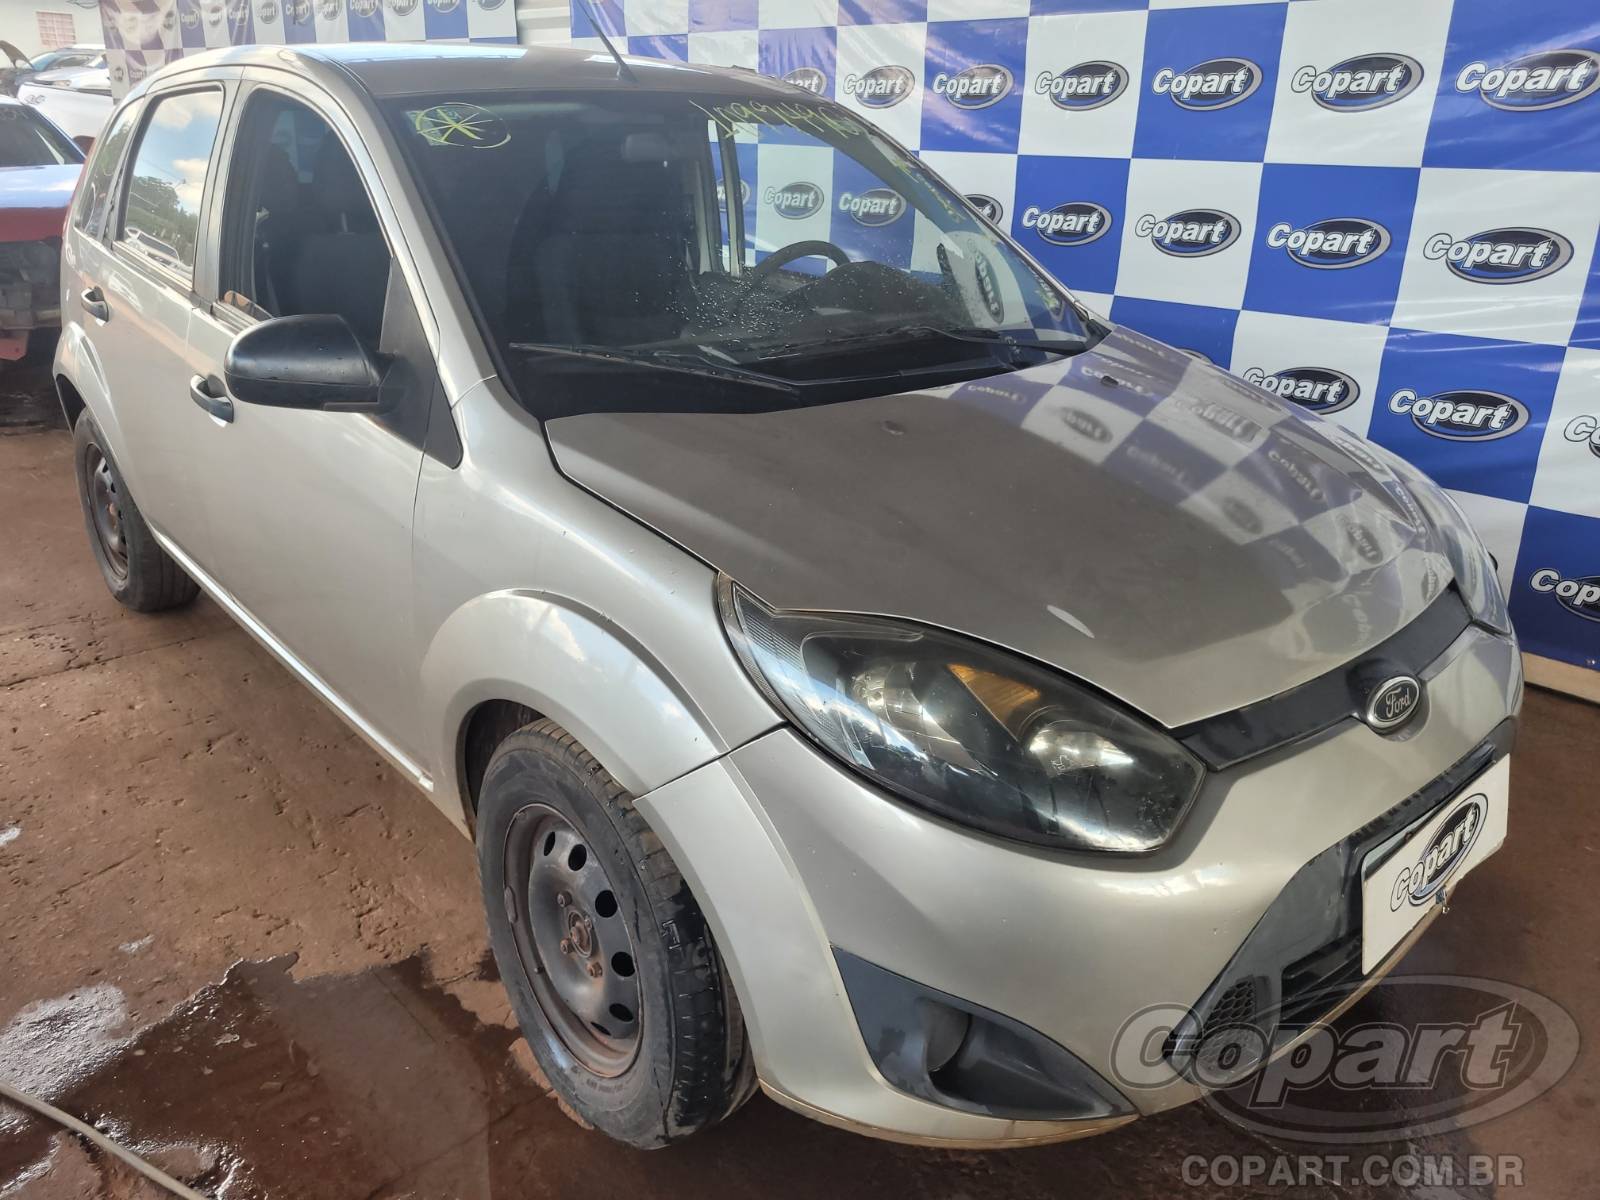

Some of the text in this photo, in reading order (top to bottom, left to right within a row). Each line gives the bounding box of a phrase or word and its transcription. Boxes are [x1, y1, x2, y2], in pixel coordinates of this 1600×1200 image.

[843, 72, 904, 98] Copart
[932, 69, 1004, 100] Copart
[1035, 67, 1117, 101] Copart
[1152, 64, 1249, 100] Copart
[1290, 61, 1411, 99] Copart
[1455, 57, 1592, 99] Copart
[763, 186, 817, 211] Copart
[838, 191, 899, 217] Copart
[1022, 206, 1101, 236] Copart
[1135, 214, 1227, 251] Copart
[1266, 223, 1379, 257] Copart
[1423, 233, 1555, 271] Copart
[1243, 367, 1345, 404] Copart
[1388, 388, 1513, 430] Copart
[1385, 687, 1412, 719] Ford
[1390, 802, 1478, 912] Copart
